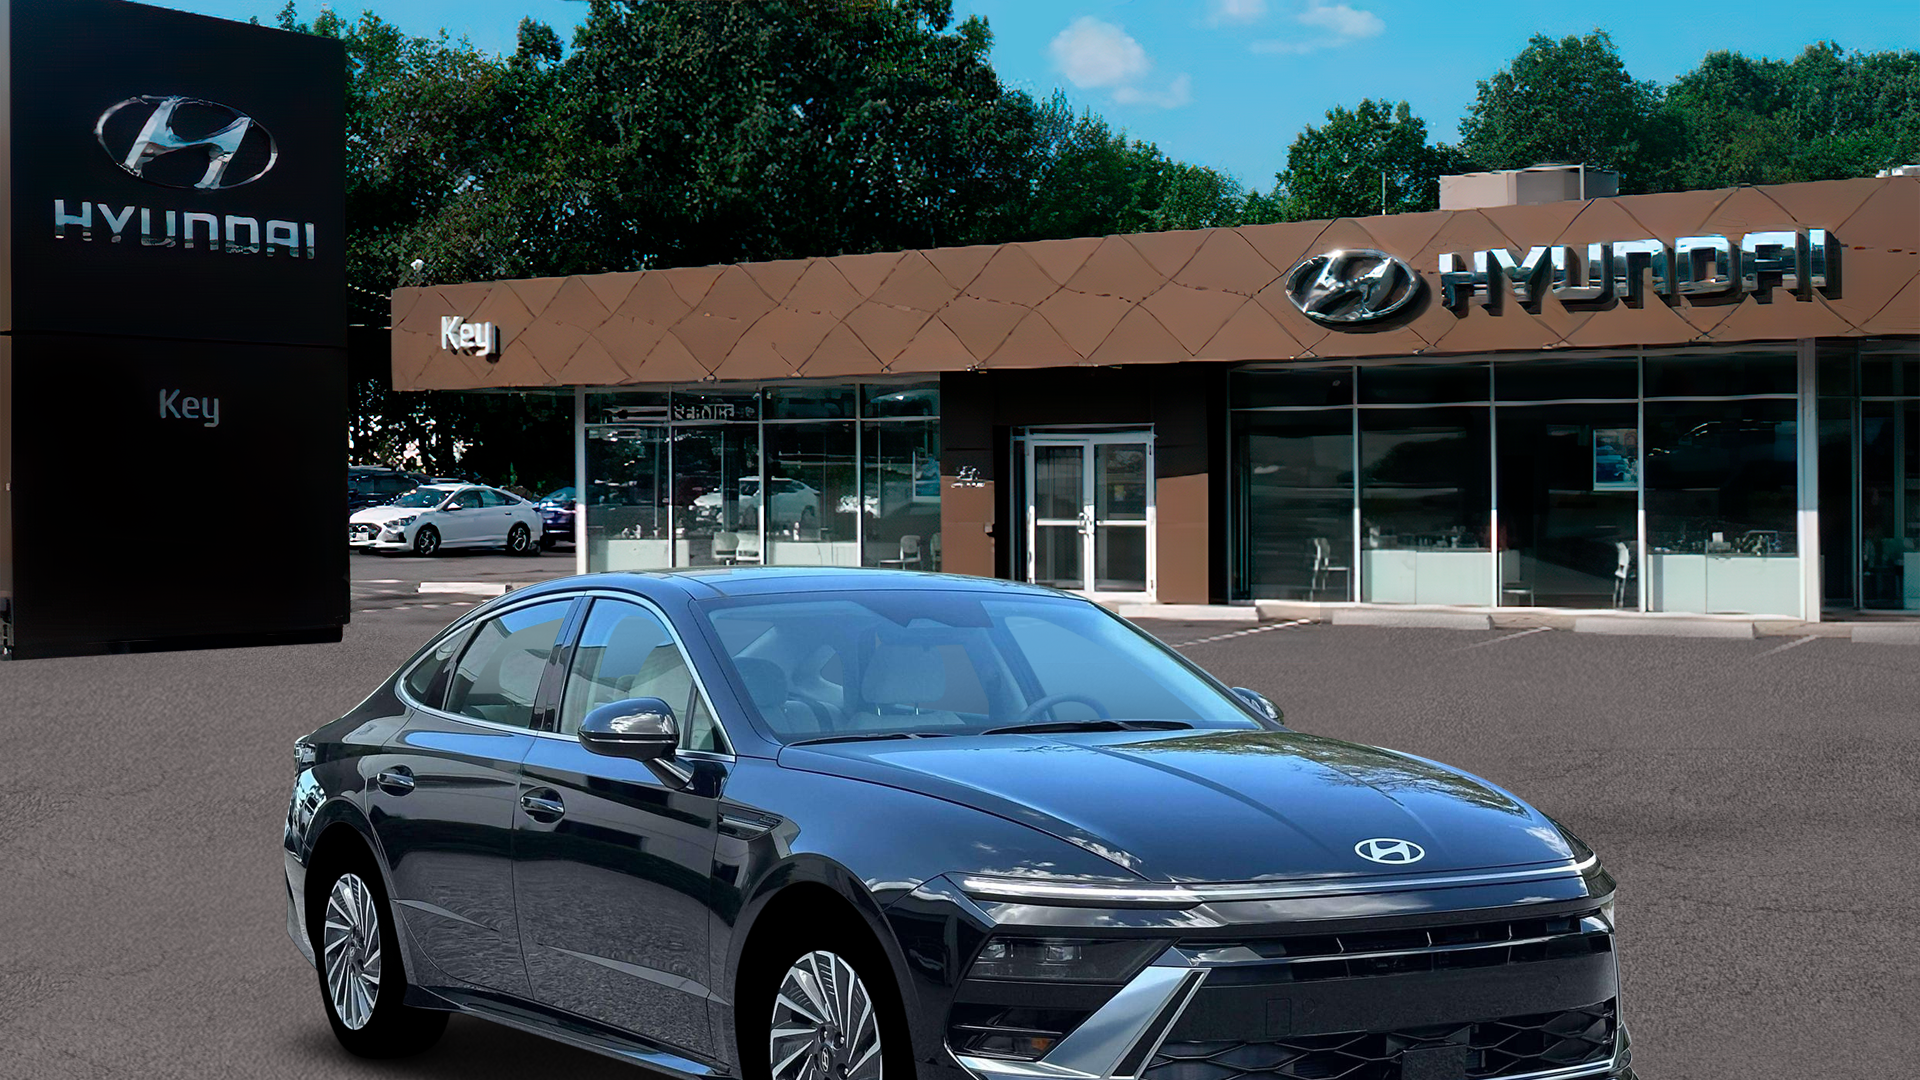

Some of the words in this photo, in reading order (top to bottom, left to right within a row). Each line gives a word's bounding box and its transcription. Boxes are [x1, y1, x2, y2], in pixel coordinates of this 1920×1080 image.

[54, 199, 315, 260] HYUNDAI
[1438, 229, 1838, 309] HYUNDAI
[441, 315, 495, 357] Key
[159, 388, 220, 428] Key
